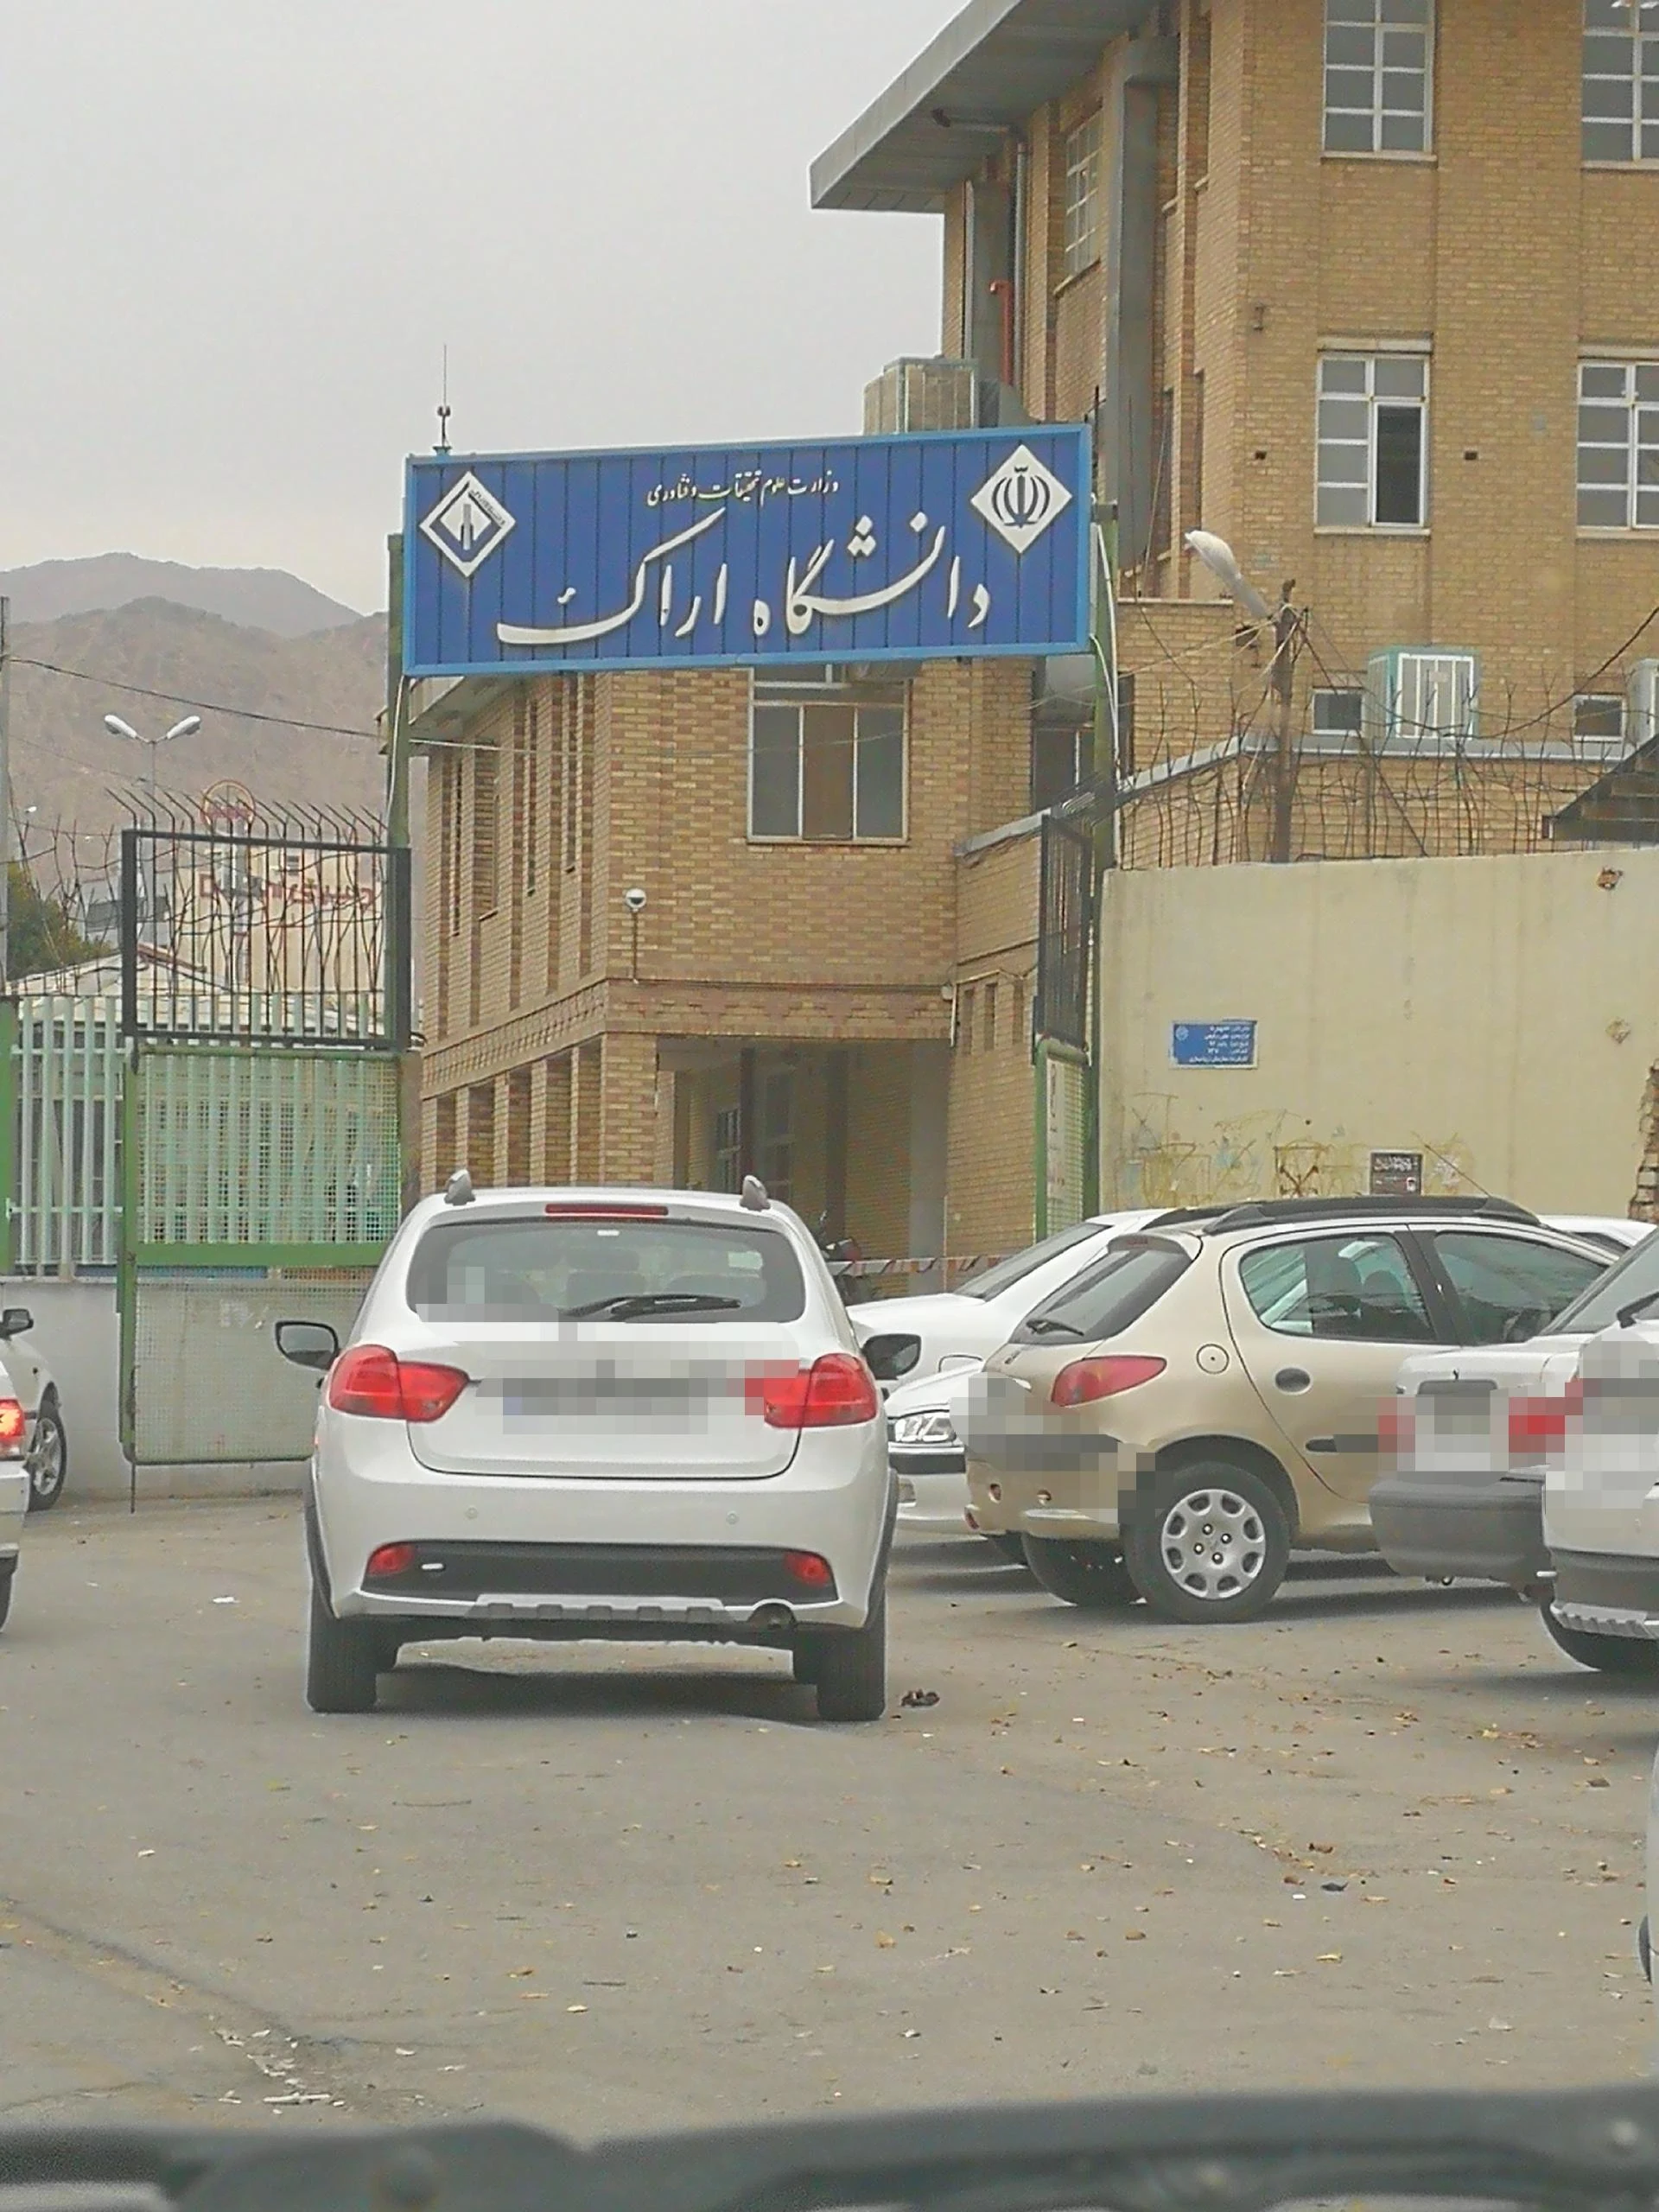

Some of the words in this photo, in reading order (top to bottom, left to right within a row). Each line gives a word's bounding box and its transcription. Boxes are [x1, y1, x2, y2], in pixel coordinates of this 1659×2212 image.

[760, 477, 785, 507] علوم
[787, 469, 839, 496] وزارت
[496, 506, 728, 645] اراک
[752, 511, 990, 637] دانشگاه
